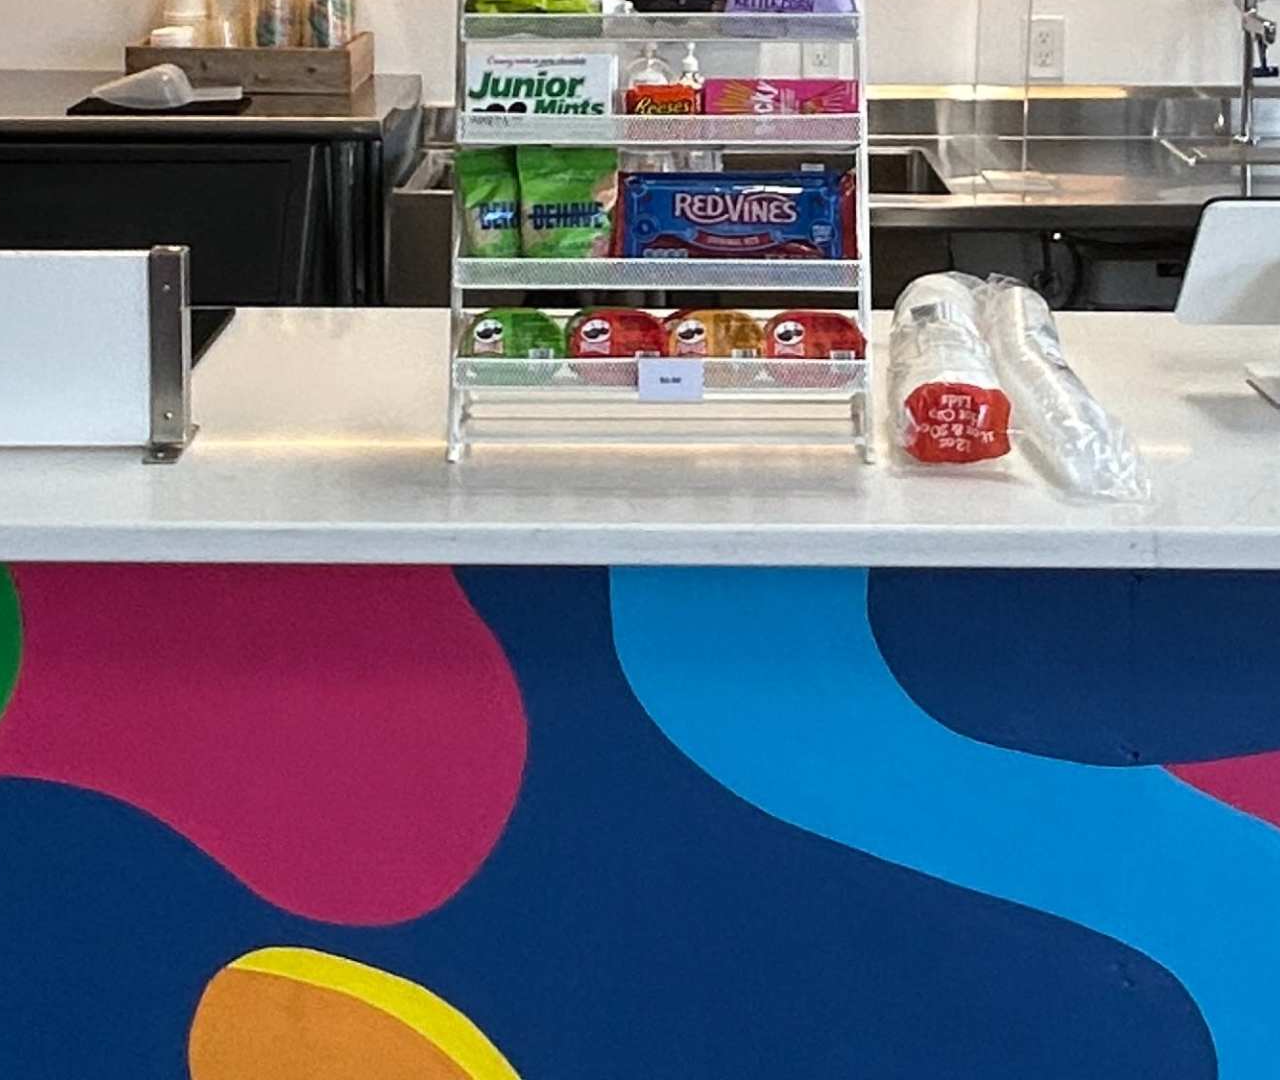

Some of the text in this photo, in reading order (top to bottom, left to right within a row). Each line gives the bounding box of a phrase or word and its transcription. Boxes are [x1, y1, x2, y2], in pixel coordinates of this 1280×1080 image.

[469, 70, 586, 99] Junior
[533, 98, 605, 115] Mints
[940, 394, 971, 408] Lids
